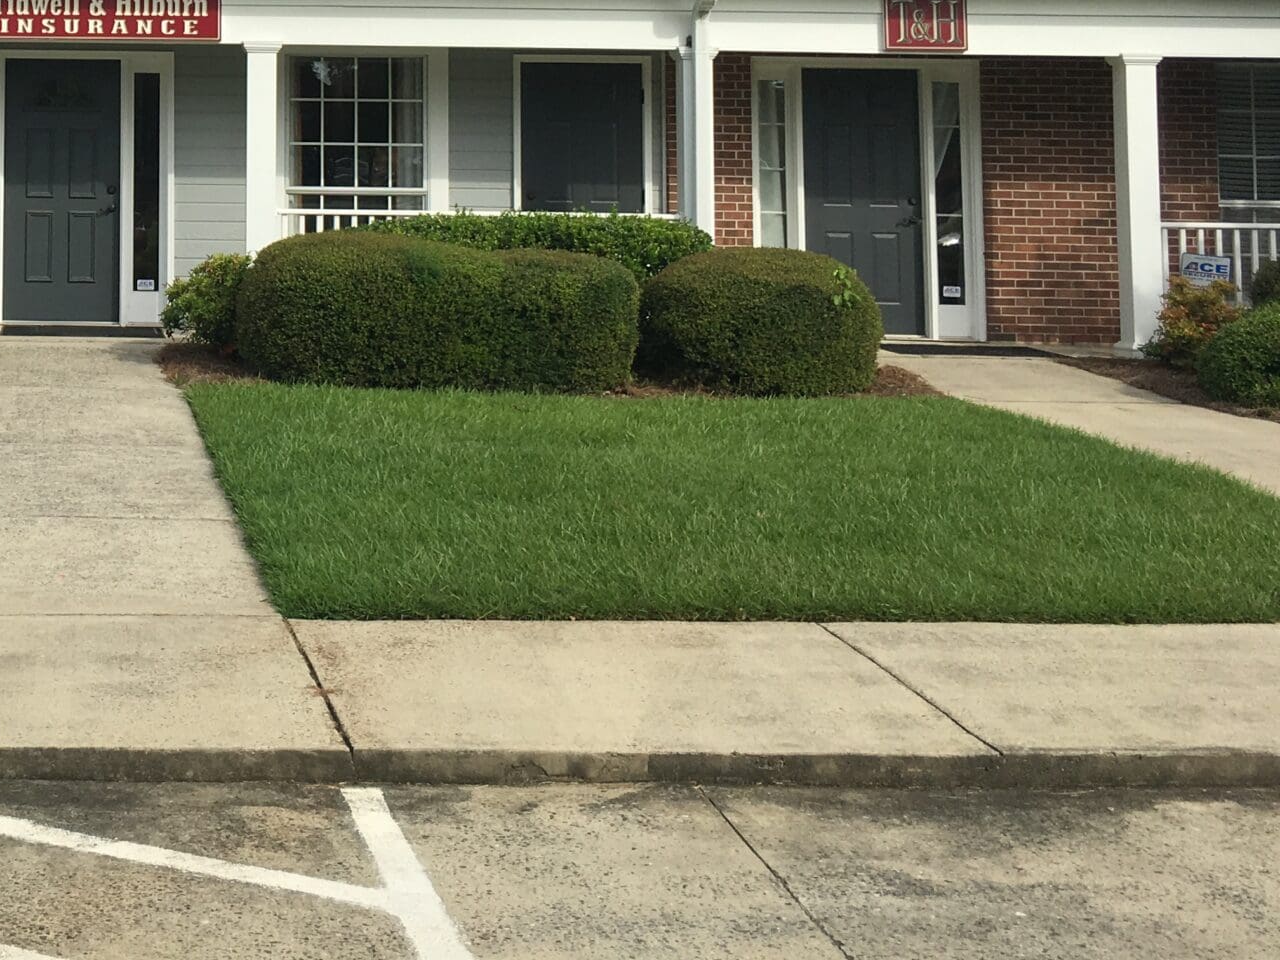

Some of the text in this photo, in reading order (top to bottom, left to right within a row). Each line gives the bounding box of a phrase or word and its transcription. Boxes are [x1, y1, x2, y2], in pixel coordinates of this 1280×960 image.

[0, 17, 199, 35] INSURANCE
[890, 0, 962, 44] T&H
[1183, 261, 1228, 273] ACE
